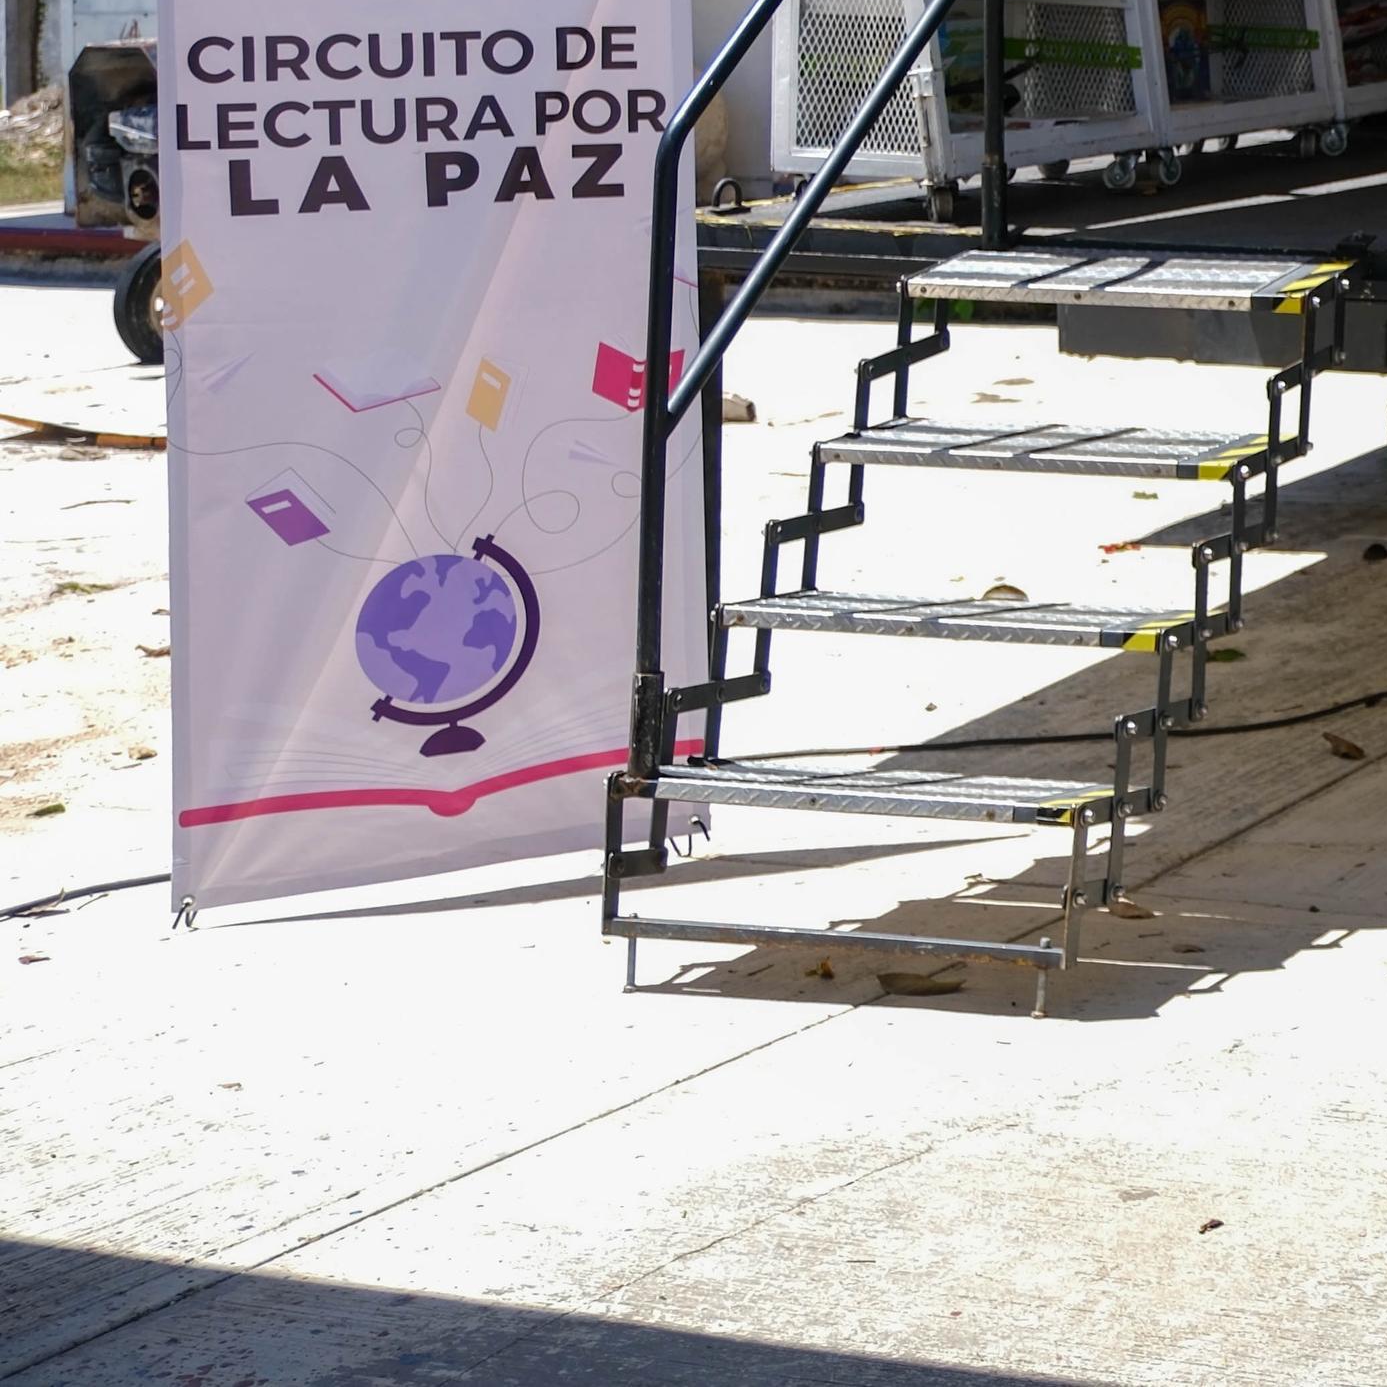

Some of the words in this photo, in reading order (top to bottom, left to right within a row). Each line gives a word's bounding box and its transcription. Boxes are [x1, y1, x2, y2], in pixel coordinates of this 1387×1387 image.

[186, 29, 534, 84] CIRCUITO
[555, 25, 638, 71] DE
[176, 94, 515, 150] LECTURA
[535, 88, 667, 136] POR
[228, 155, 371, 217] LA
[424, 143, 625, 208] PAZ
